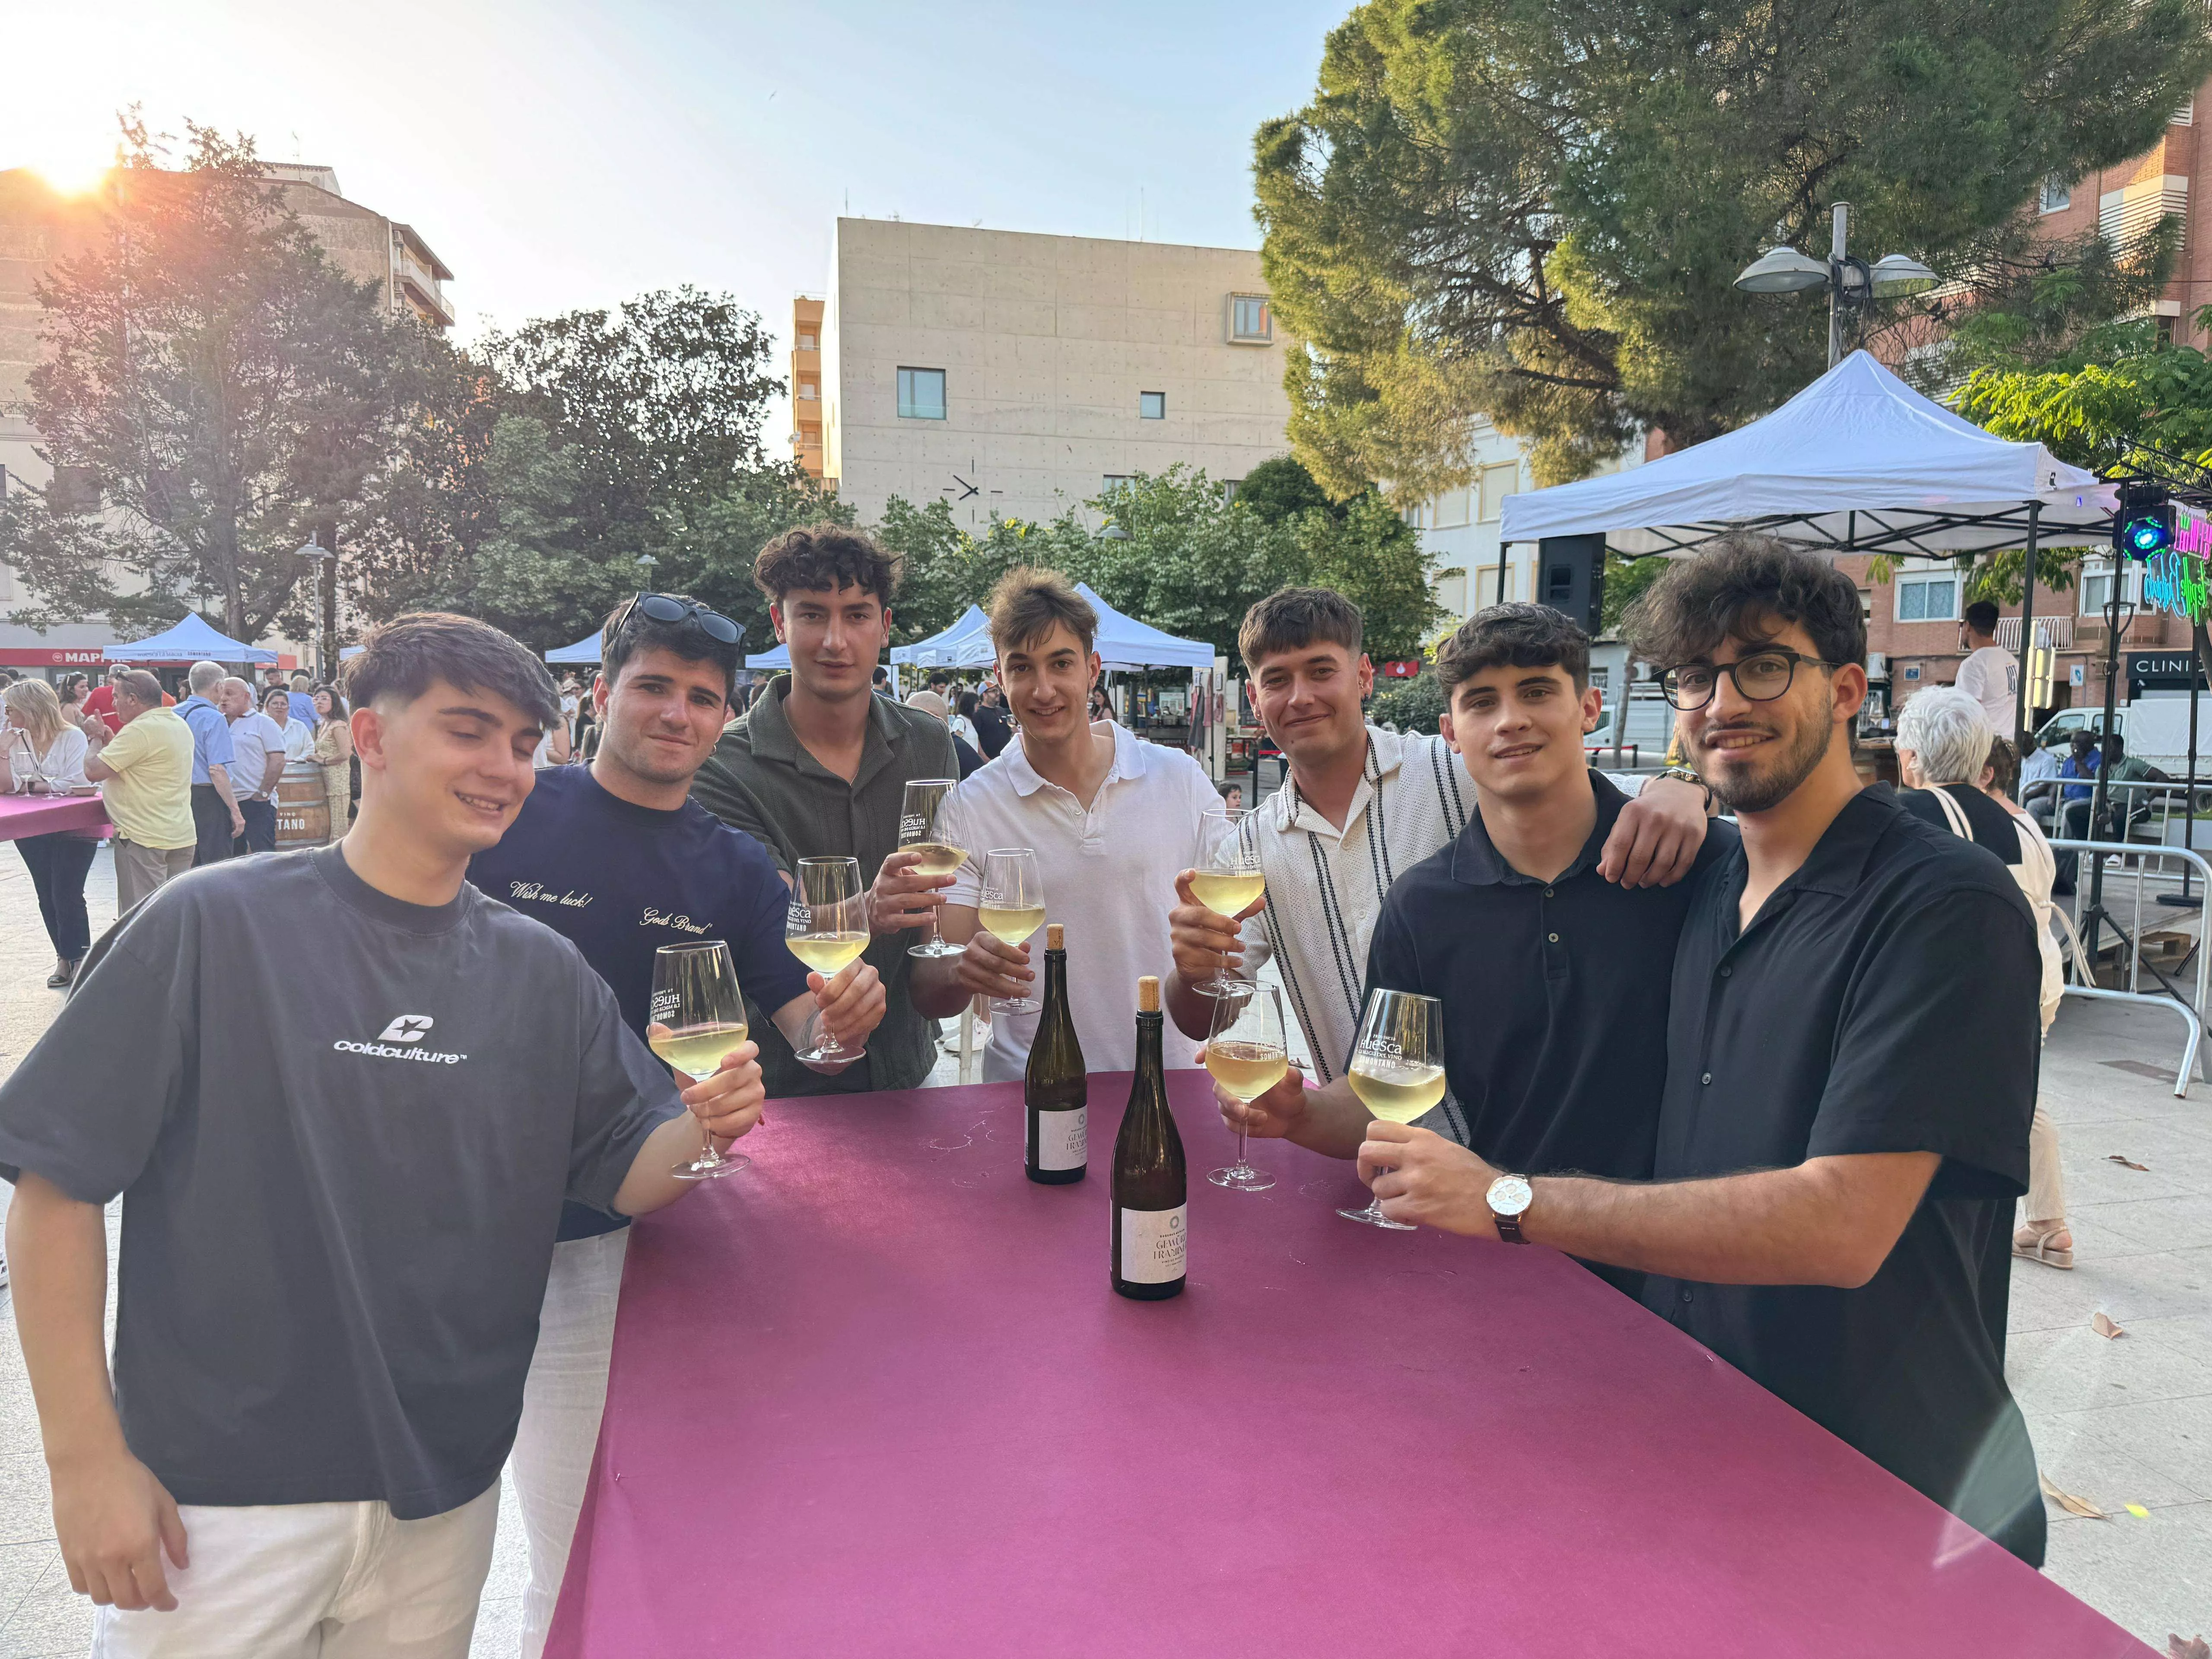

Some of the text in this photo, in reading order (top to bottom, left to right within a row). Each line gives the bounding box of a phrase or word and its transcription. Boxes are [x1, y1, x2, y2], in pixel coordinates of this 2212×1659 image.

[65, 652, 131, 663] MAP
[2136, 660, 2205, 673] CLINI
[510, 881, 594, 908] Wish me luck!
[786, 921, 807, 931] NTANO
[1360, 1039, 1402, 1055] Huesca
[1154, 1241, 1186, 1259] TRAMIN
